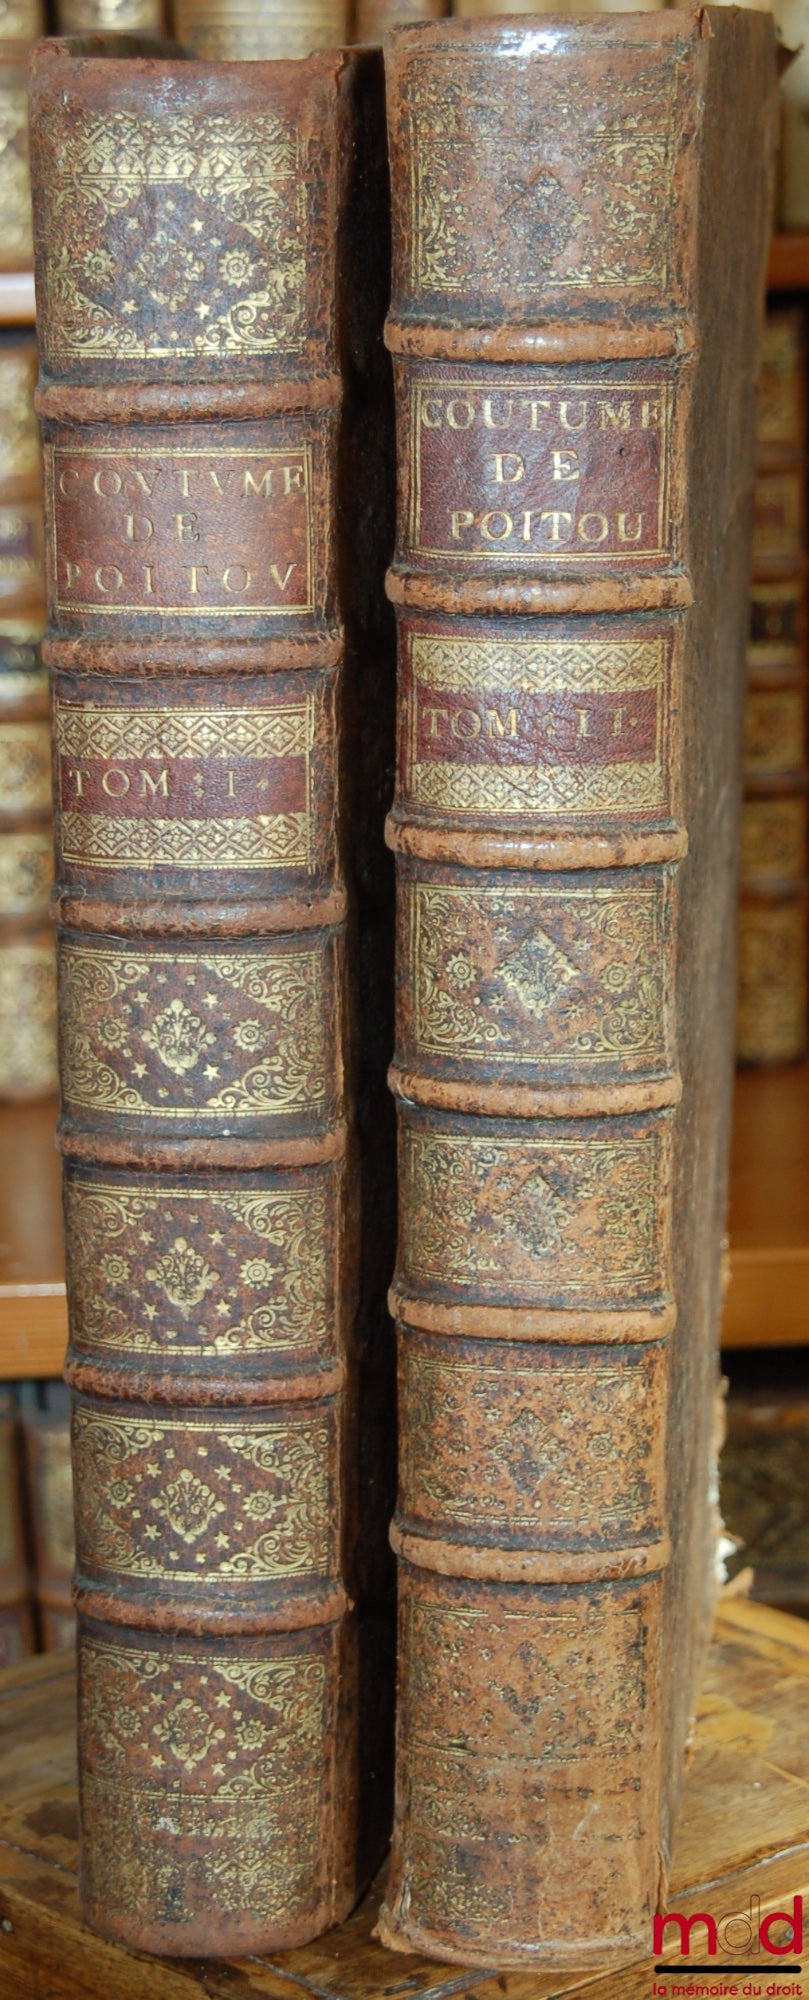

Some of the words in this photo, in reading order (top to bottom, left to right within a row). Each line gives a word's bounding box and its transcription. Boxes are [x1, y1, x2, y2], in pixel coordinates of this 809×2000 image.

[421, 398, 664, 431] COUTUME
[490, 450, 581, 484] DE
[125, 512, 202, 543] DE
[450, 510, 645, 543] POITOU
[65, 562, 297, 594] POITOV
